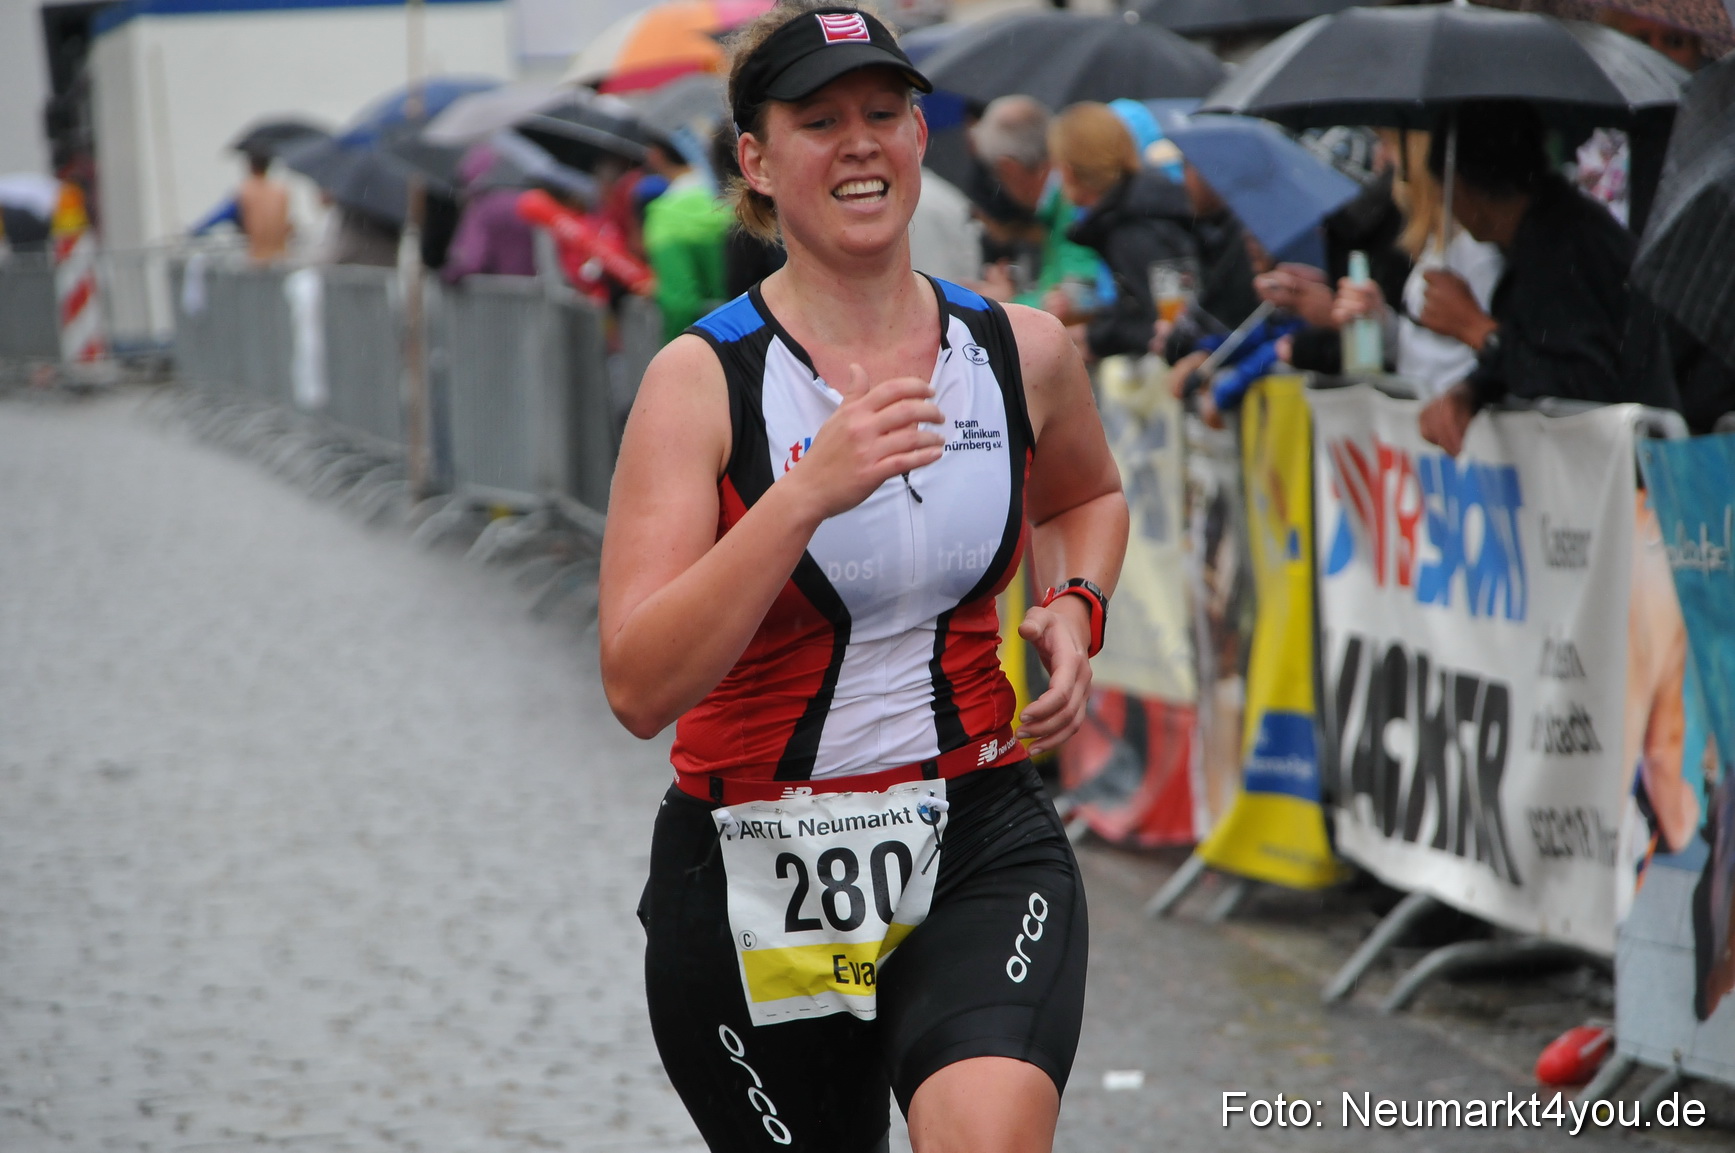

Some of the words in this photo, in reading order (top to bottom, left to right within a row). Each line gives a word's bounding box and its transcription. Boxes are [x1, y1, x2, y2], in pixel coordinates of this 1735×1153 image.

[954, 419, 979, 429] team
[962, 428, 1001, 440] klinikum
[944, 440, 992, 452] nürnberg
[726, 819, 792, 841] ARTL
[797, 806, 914, 838] Neumarkt
[774, 840, 913, 933] 280
[1006, 892, 1049, 984] orca
[832, 953, 877, 987] Eva
[718, 1024, 792, 1145] orca
